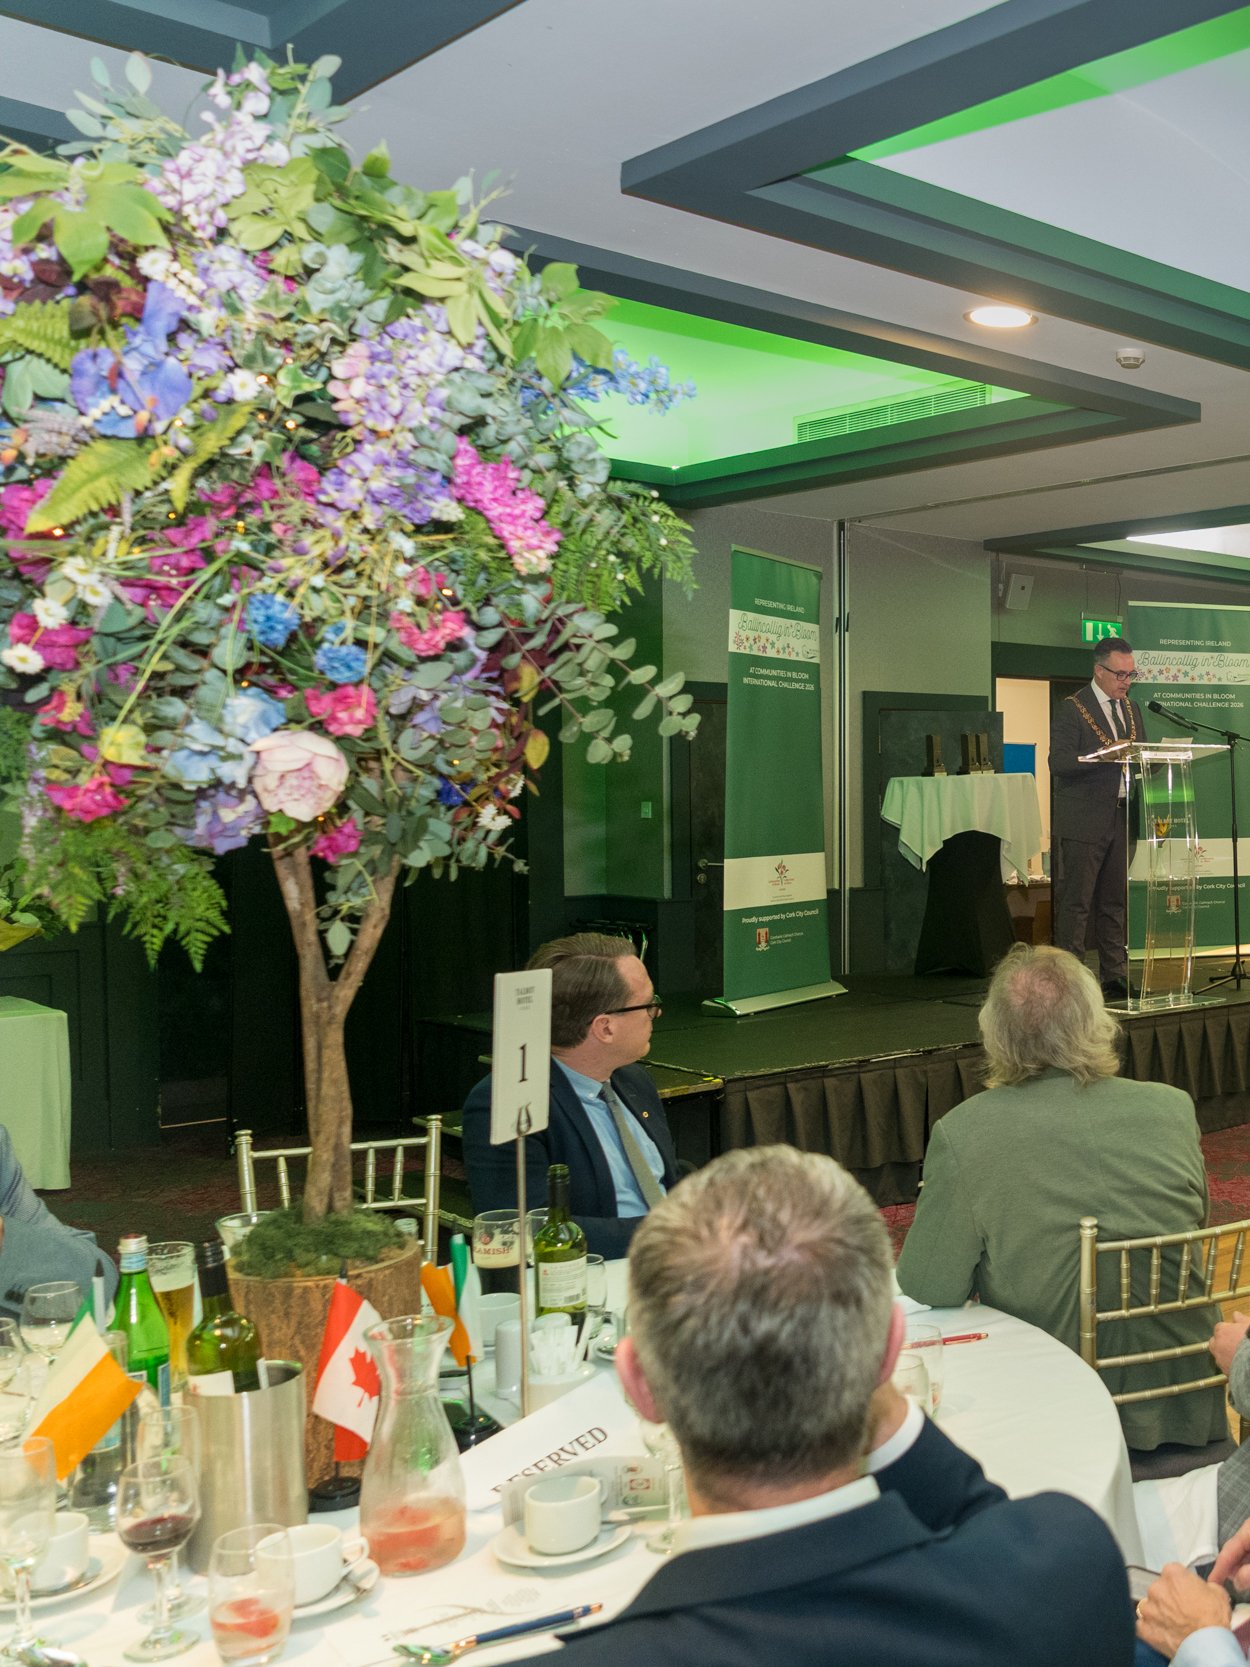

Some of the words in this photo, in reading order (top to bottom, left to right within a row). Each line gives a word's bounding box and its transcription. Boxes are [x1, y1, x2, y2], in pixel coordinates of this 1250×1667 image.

[755, 598, 786, 610] REPRESENTING
[787, 604, 804, 614] IRELAND
[738, 612, 783, 641] Ballincollig
[783, 624, 791, 638] in
[792, 622, 817, 642] Bloom
[1160, 639, 1205, 647] REPRESENTING
[1137, 651, 1199, 671] Ballincollig
[1200, 655, 1211, 667] in
[1212, 654, 1250, 668] Bloom
[756, 668, 786, 676] COMMUNITIES
[743, 678, 778, 687] INTERNATIONAL
[779, 682, 805, 690] CHALLENGE
[1162, 692, 1205, 700] COMMUNITIES
[759, 914, 780, 922] supported
[517, 1043, 529, 1084] 1
